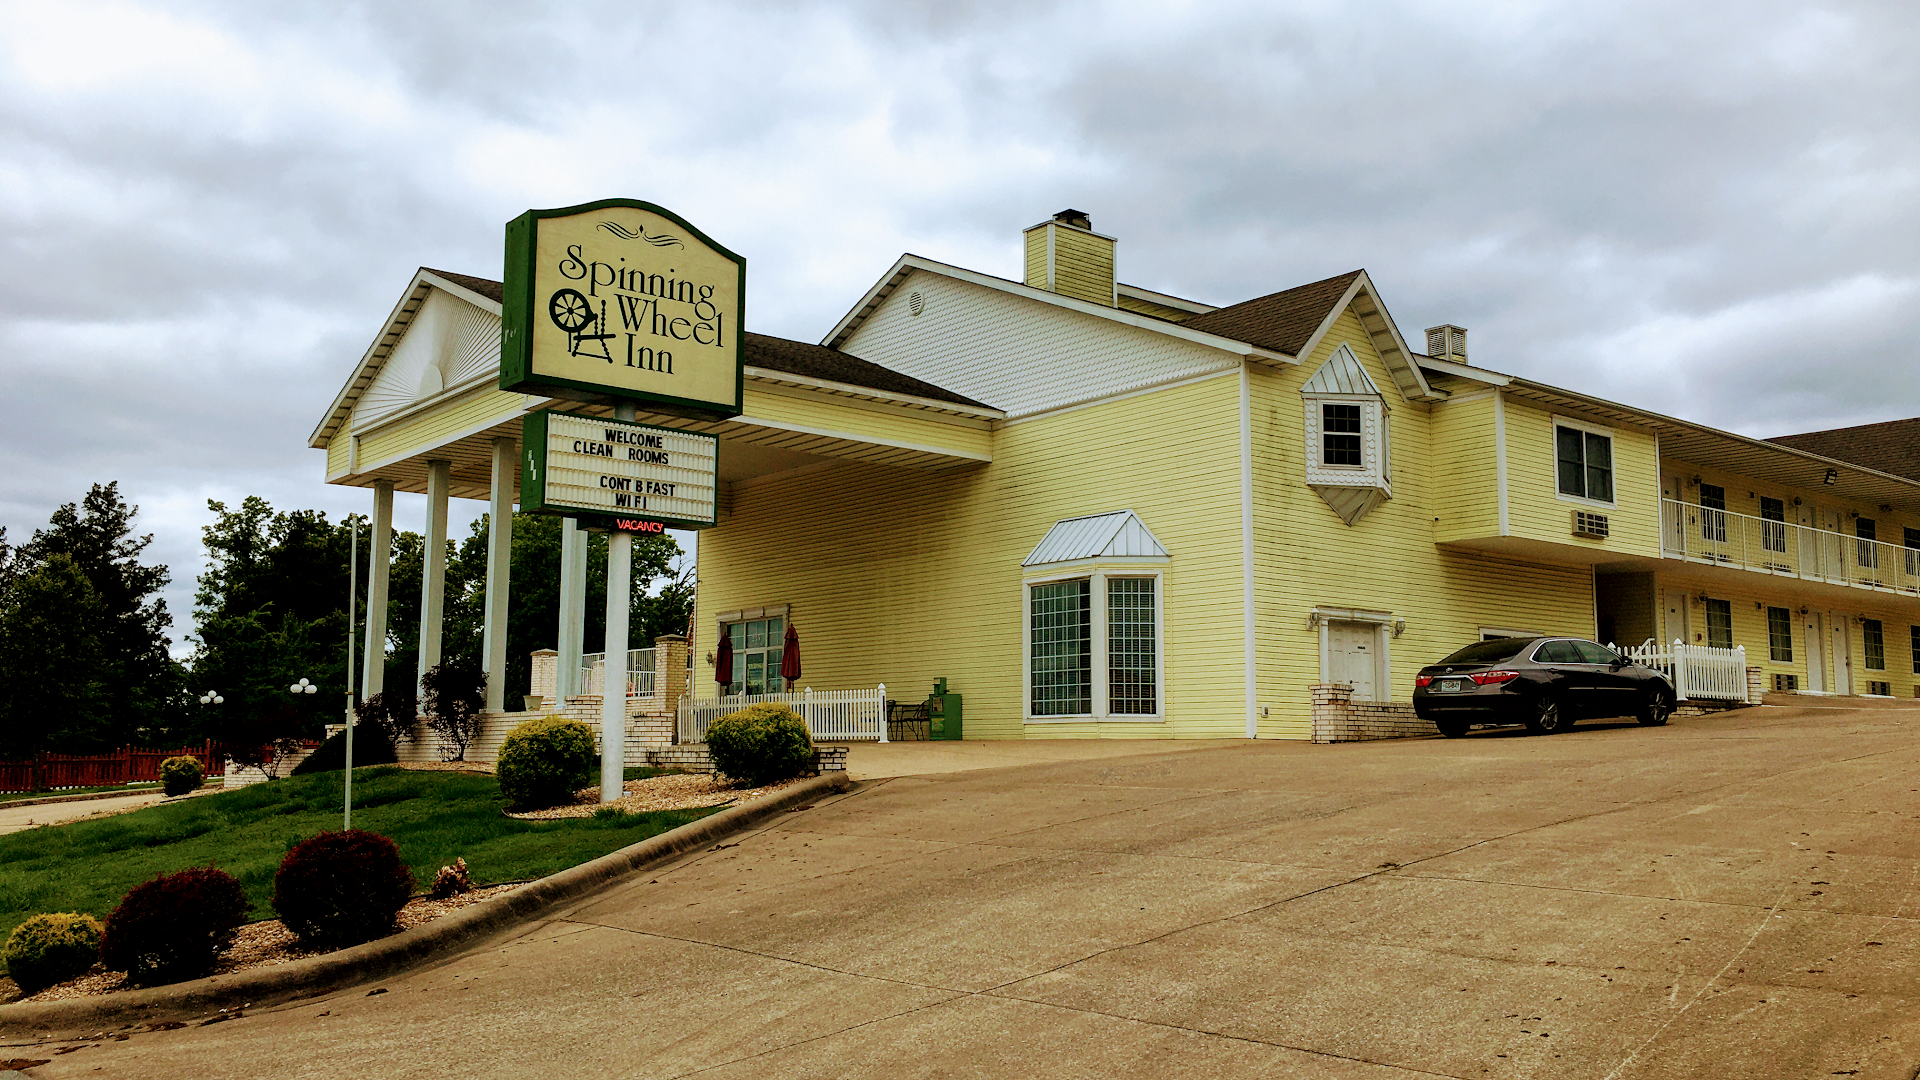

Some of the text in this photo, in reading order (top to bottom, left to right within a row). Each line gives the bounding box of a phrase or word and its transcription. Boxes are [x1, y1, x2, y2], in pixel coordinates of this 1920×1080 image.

[558, 244, 716, 321] Spinning
[613, 293, 724, 348] Wheel
[624, 332, 674, 375] Inn
[605, 428, 663, 449] WELCOME
[573, 440, 669, 465] CLEAN ROOMS
[600, 475, 632, 491] CONT
[616, 518, 664, 533] VACANCY
